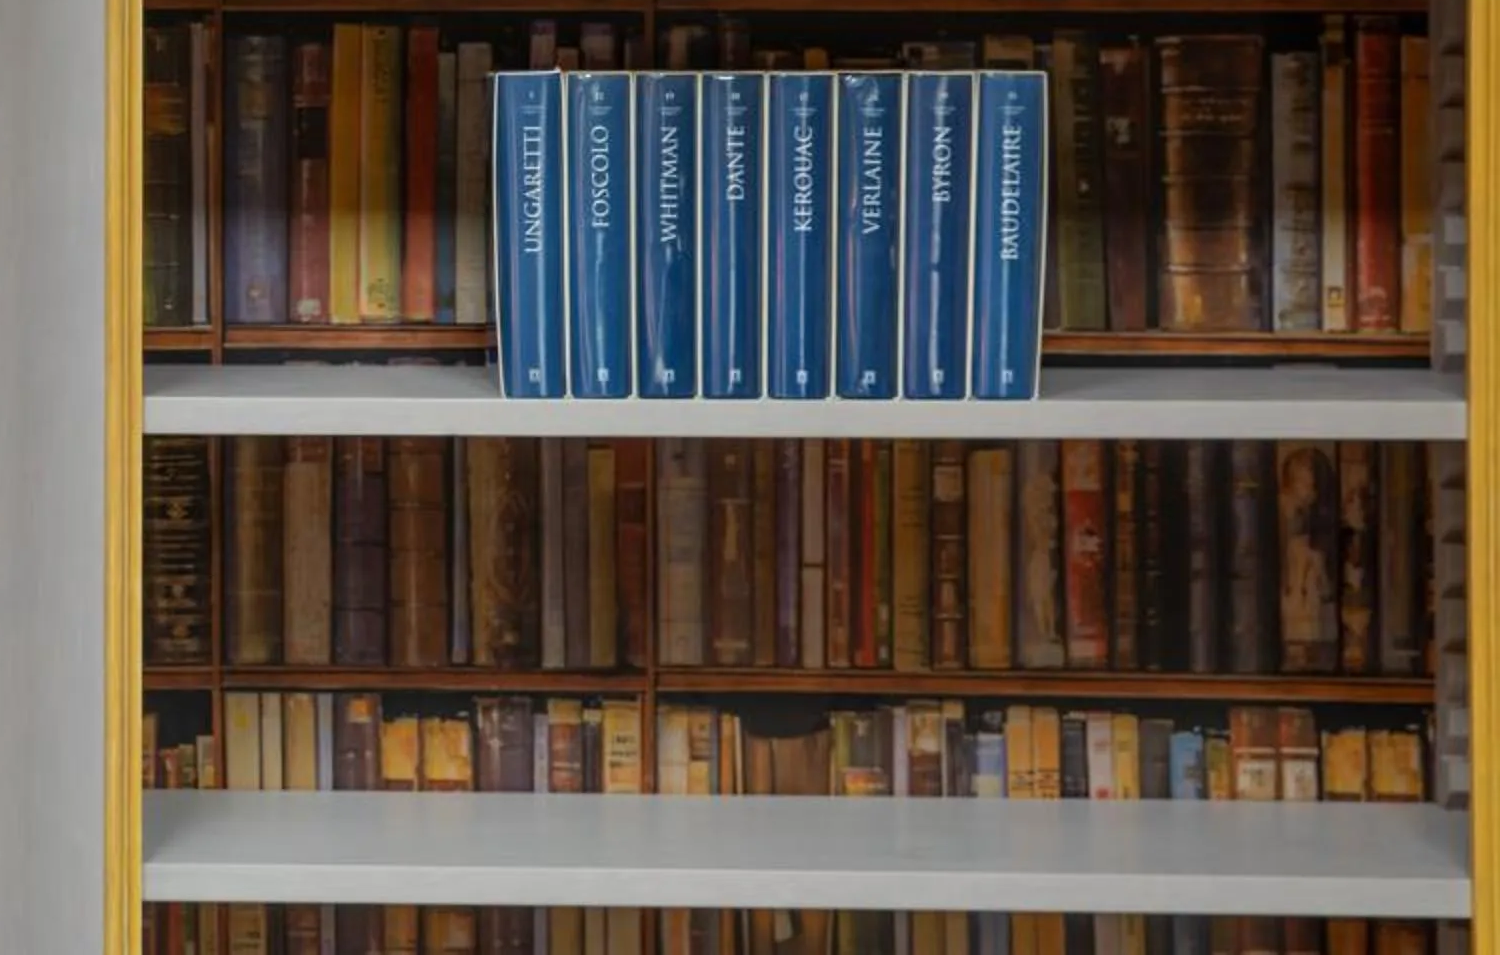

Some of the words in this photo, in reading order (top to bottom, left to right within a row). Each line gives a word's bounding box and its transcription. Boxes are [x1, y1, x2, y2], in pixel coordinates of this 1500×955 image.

[523, 126, 543, 252] UNGARETTI
[590, 125, 609, 227] FOSCOLO
[660, 126, 677, 242] WHITMAN
[726, 126, 743, 201] DANTE
[794, 127, 812, 232] KEROUAC
[862, 128, 882, 234] VERLAINE
[932, 126, 949, 203] BYRON
[1001, 127, 1020, 260] BAUDELAIRE
